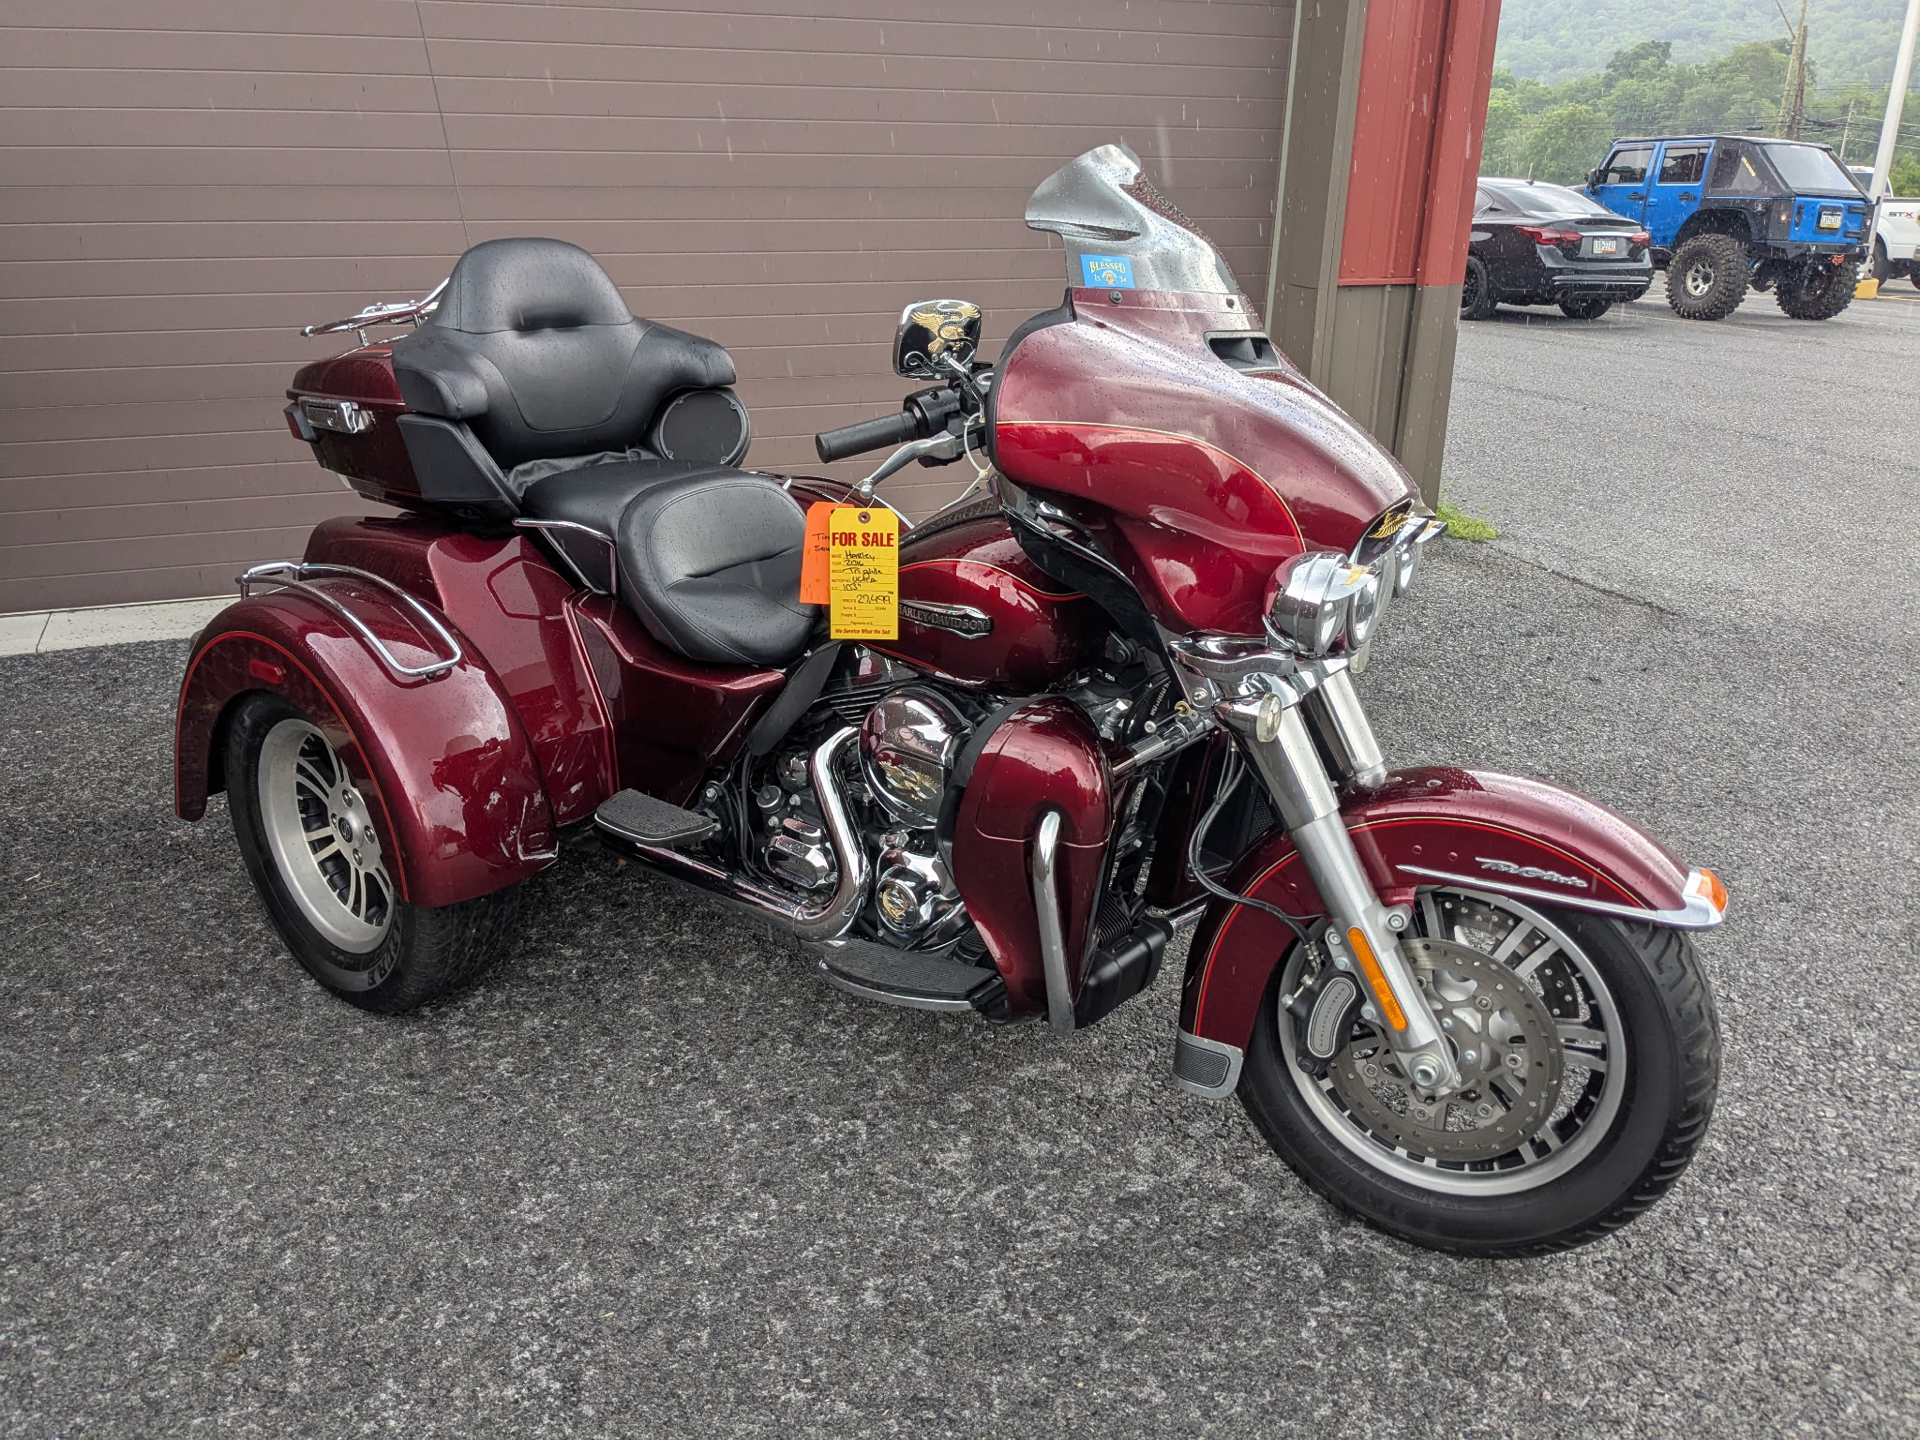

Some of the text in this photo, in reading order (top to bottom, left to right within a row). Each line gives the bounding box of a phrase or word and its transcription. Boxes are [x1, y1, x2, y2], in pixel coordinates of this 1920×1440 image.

[1089, 261, 1126, 273] BLESSED
[831, 532, 894, 547] FOR SALE
